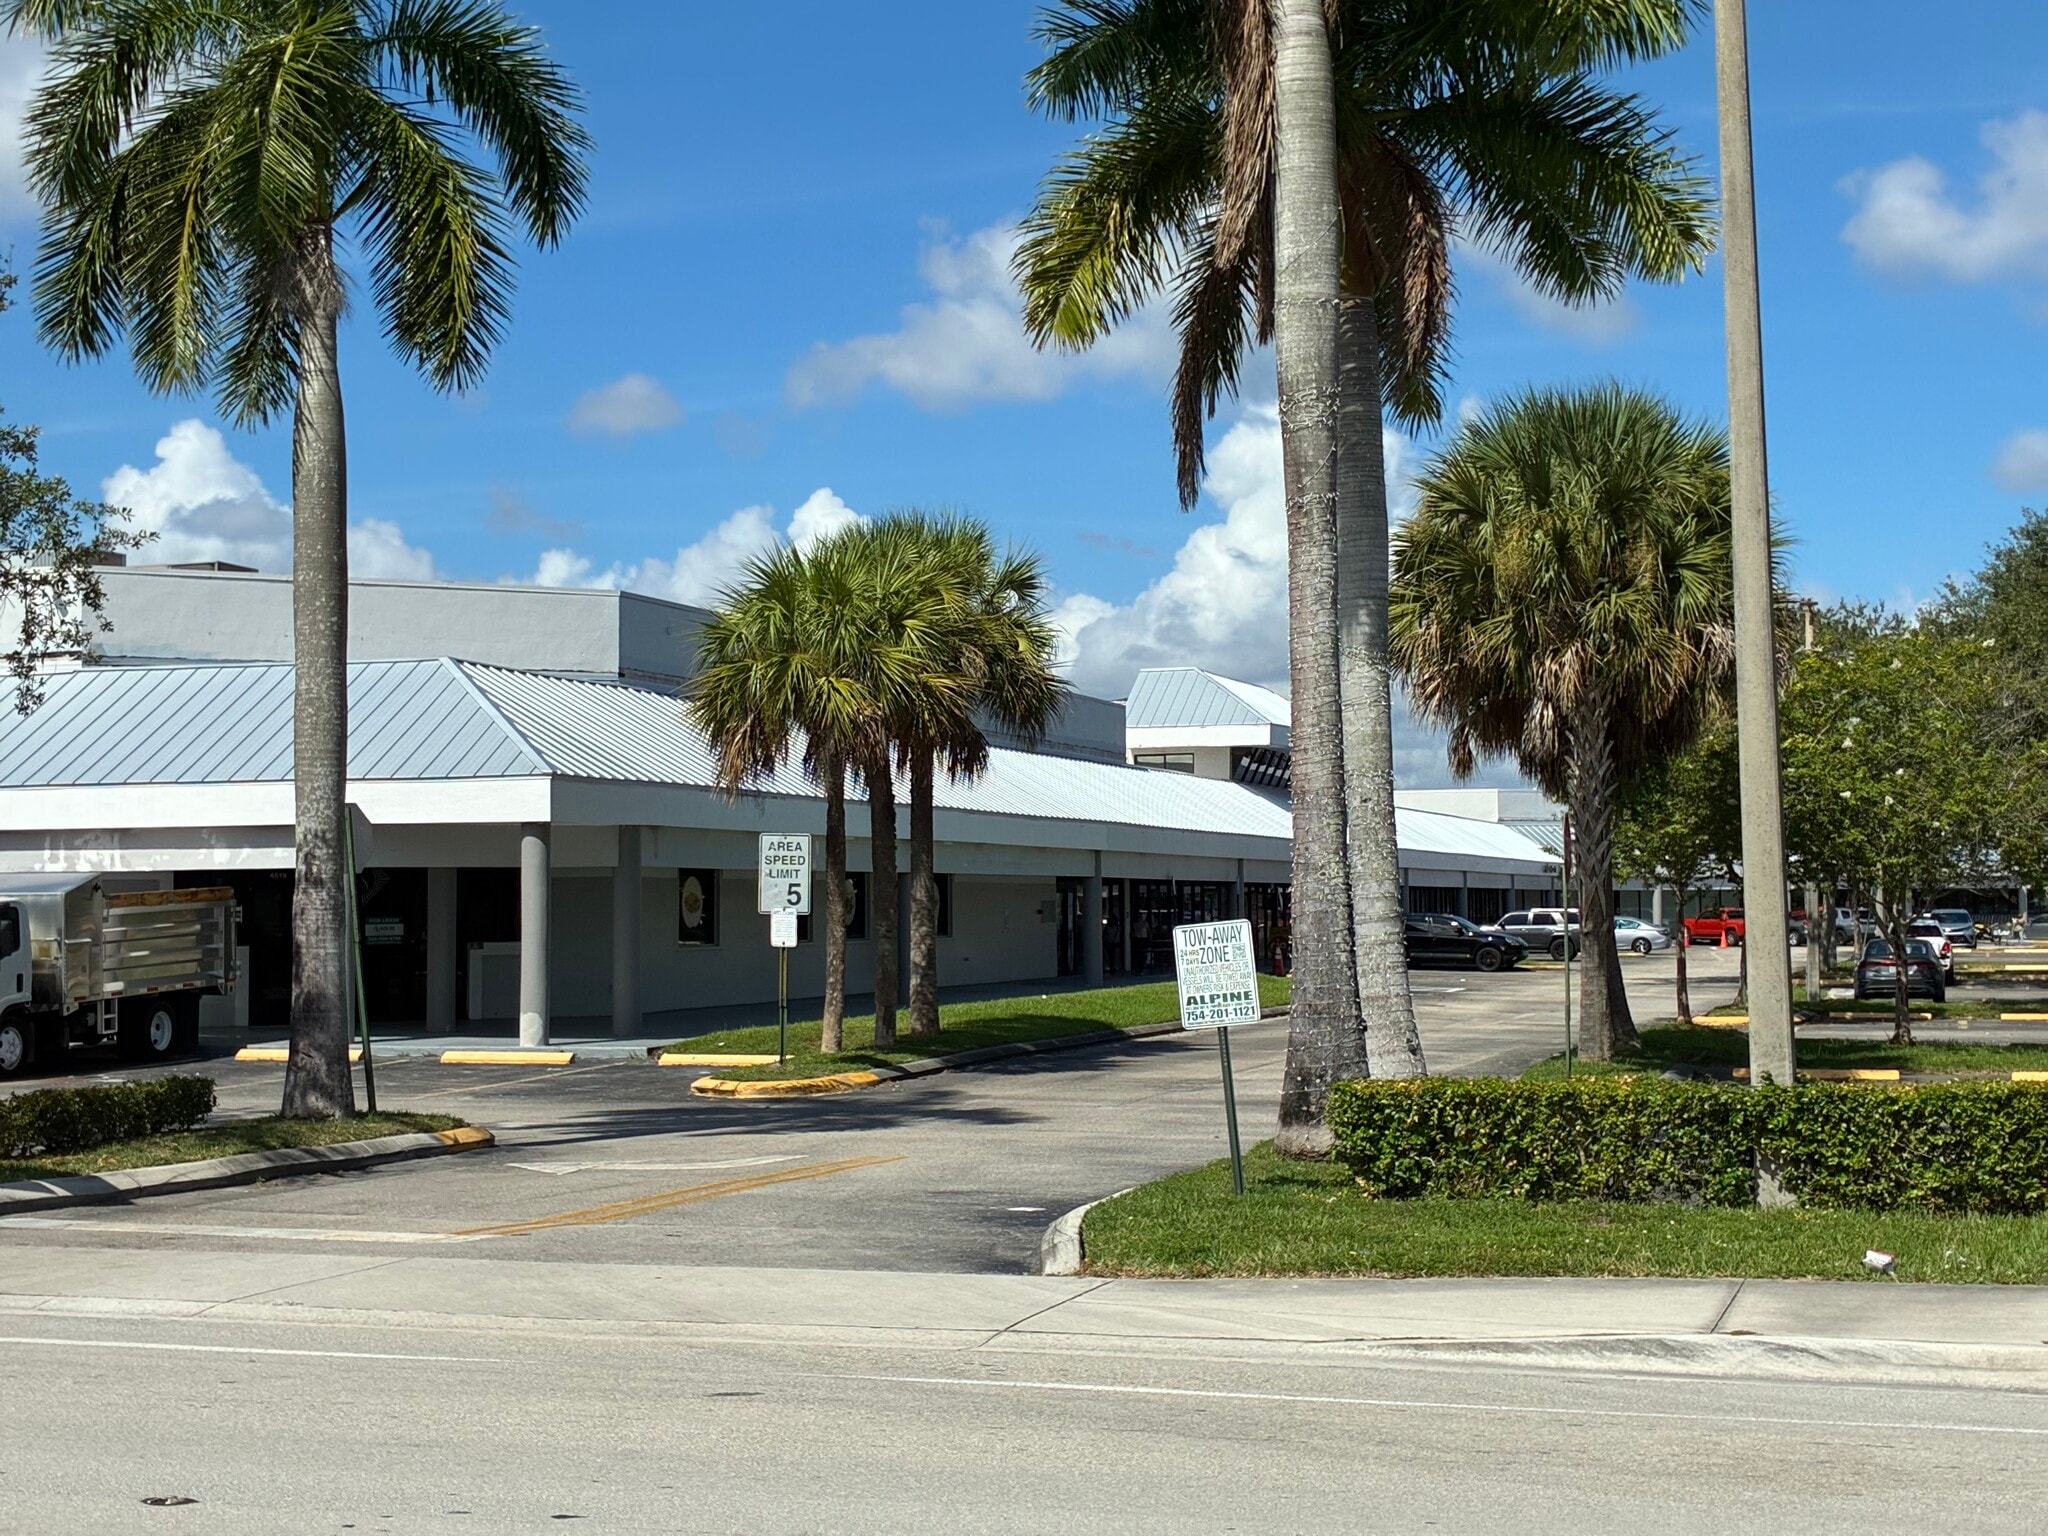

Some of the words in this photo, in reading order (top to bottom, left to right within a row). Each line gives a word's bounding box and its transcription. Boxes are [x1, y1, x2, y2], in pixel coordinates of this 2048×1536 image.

[768, 841, 802, 852] AREA
[764, 855, 806, 866] SPEED
[769, 869, 801, 879] LIMIT
[786, 883, 802, 906] 5
[1181, 924, 1243, 948] TOW-AWAY
[1180, 949, 1188, 958] 24
[1188, 949, 1200, 957] HRS
[1199, 945, 1230, 965] ZONE
[1180, 958, 1185, 966] 7
[1186, 957, 1200, 966] DAYS
[1183, 964, 1219, 977] UNAUTHORIZED
[1220, 962, 1242, 973] VEHICLES
[1203, 974, 1214, 984] WILL
[1215, 973, 1222, 983] BE
[1223, 973, 1238, 982] TOWED
[1213, 983, 1224, 992] RISK
[1229, 980, 1251, 990] EXPENSE
[1186, 990, 1254, 1007] ALPINE
[1186, 1006, 1256, 1022] 754-201-1121
